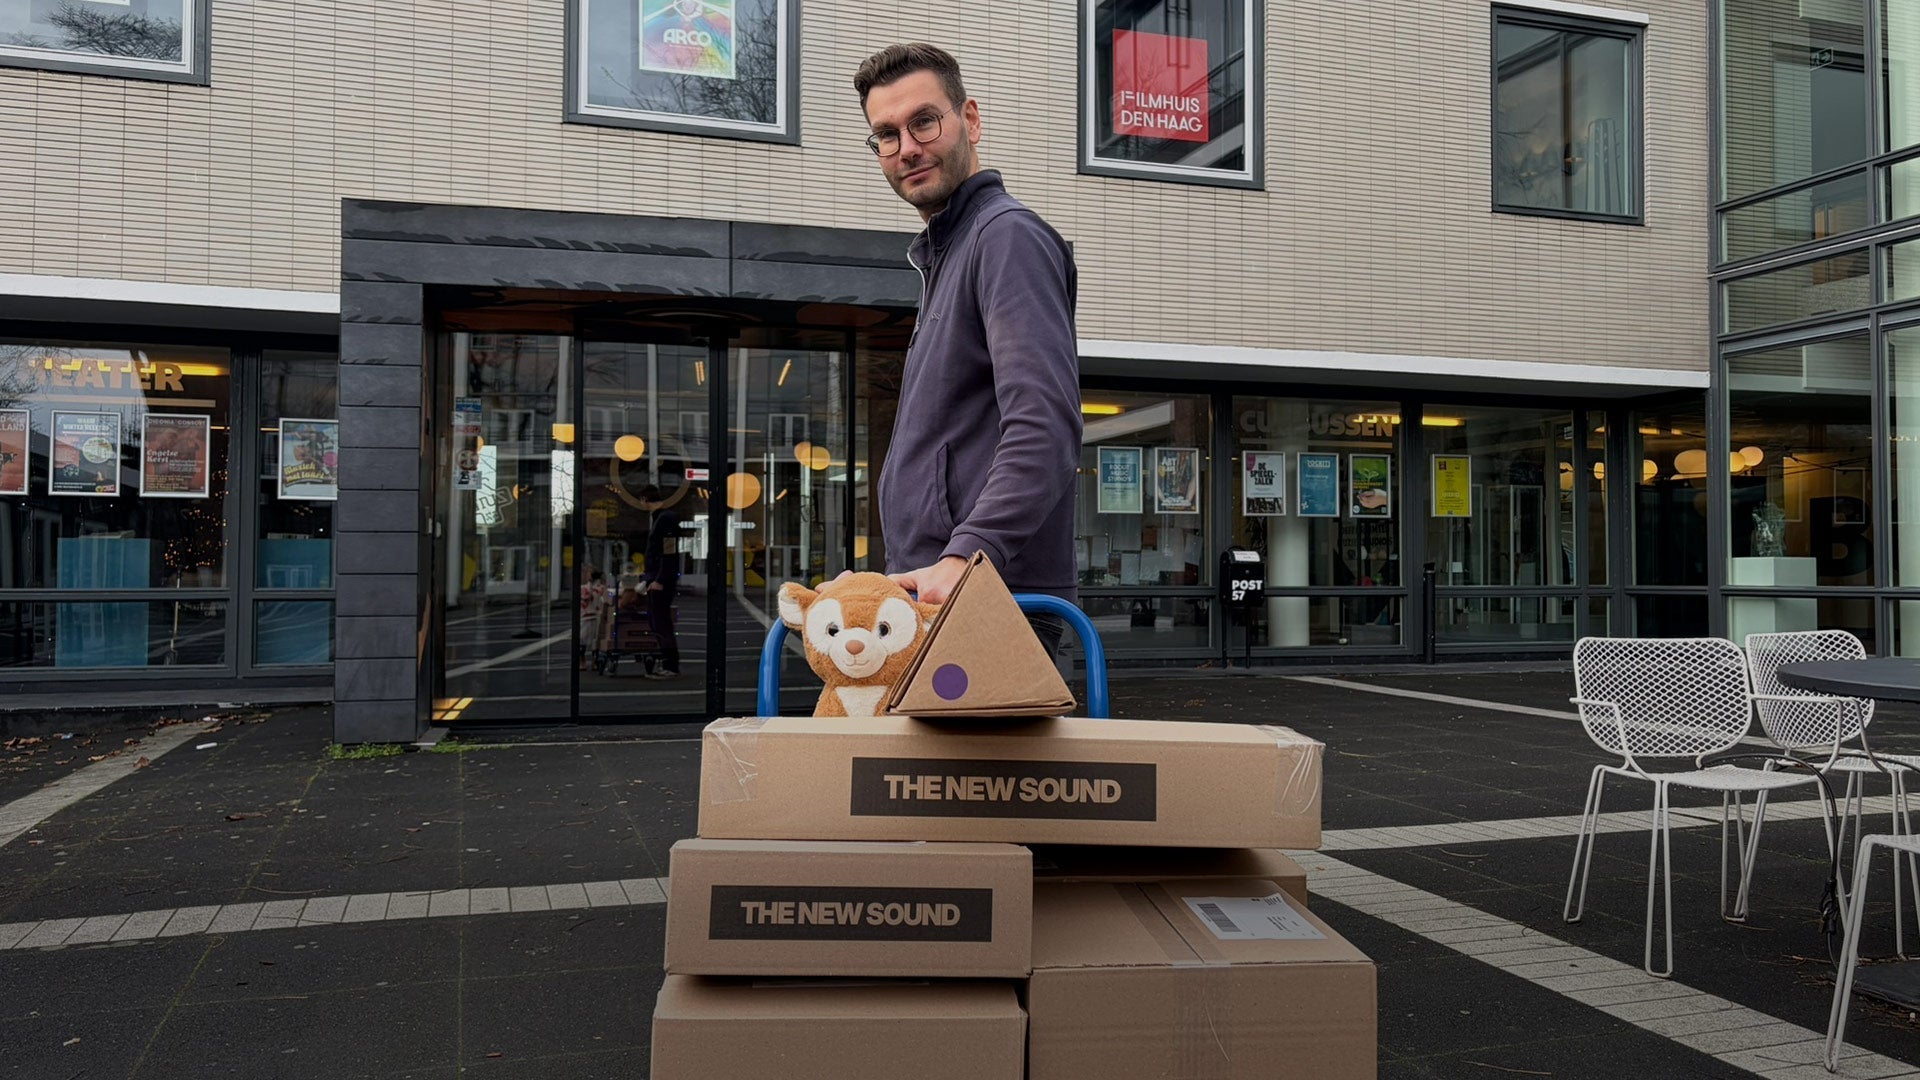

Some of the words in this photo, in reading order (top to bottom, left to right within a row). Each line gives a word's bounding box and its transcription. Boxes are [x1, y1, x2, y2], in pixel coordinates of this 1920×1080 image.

[663, 28, 712, 46] ARCO
[1121, 90, 1200, 113] FILMHUIS
[1121, 110, 1155, 128] DEN
[1157, 113, 1203, 132] HAAG
[23, 356, 184, 392] EATER
[0, 423, 25, 431] LAND
[1239, 410, 1393, 437] CUUSSEN
[1258, 462, 1266, 470] DE
[1254, 477, 1273, 485] ZALEN
[1232, 580, 1263, 590] POST
[1232, 590, 1245, 600] 57
[883, 774, 942, 800] THE
[945, 775, 1017, 801] NEW
[1018, 777, 1122, 804] SOUND
[740, 901, 796, 925] THE
[798, 902, 864, 926] NEW
[866, 903, 961, 927] SOUND
